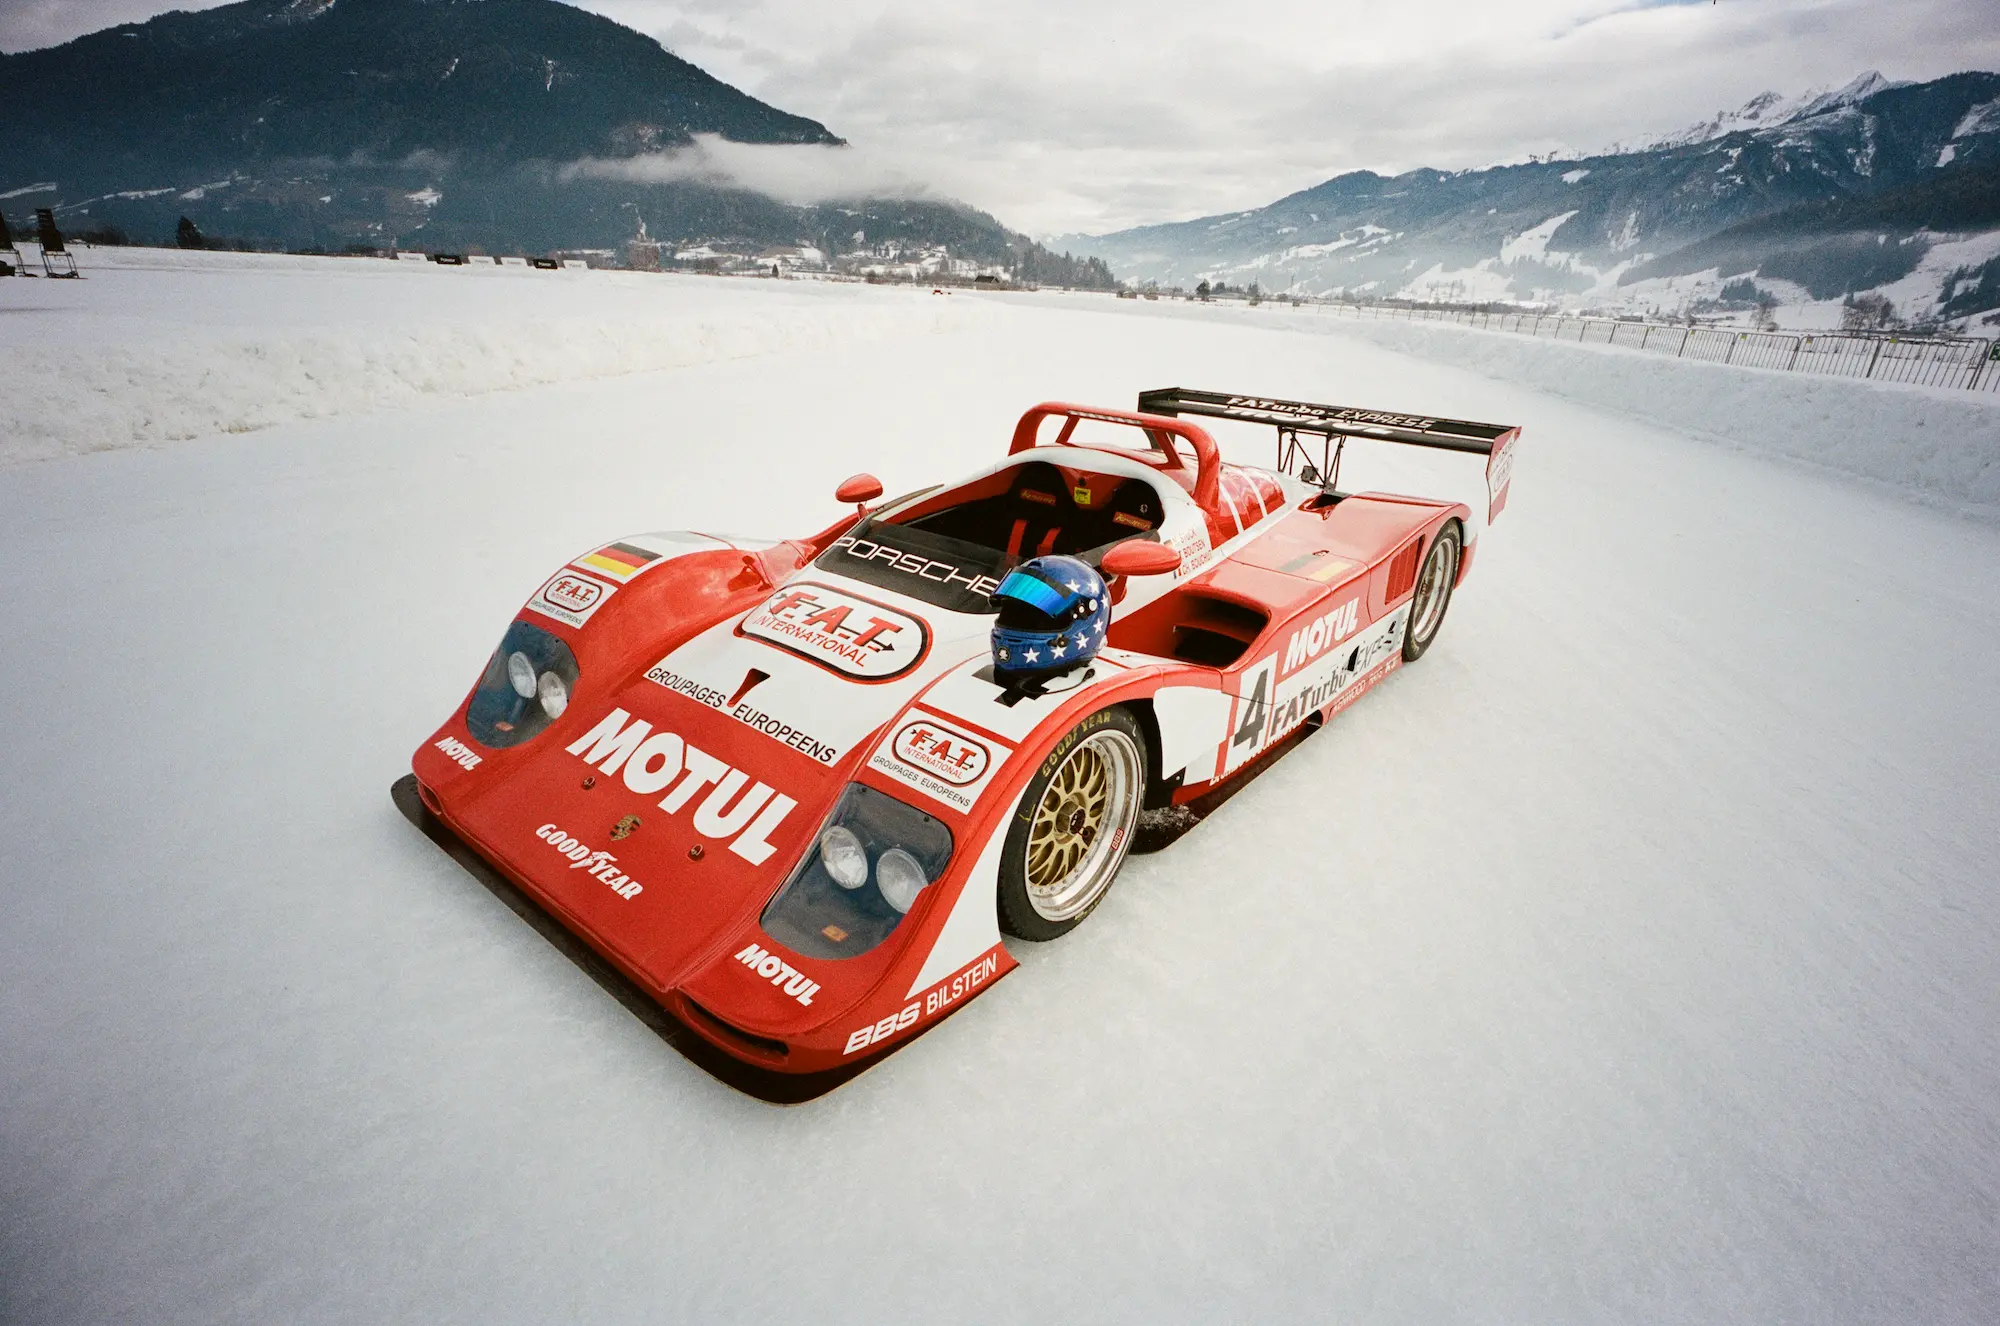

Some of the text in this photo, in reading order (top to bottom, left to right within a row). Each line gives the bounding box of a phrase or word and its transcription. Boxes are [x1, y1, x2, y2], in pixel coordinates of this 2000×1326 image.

[834, 536, 1001, 598] PORSCHE
[752, 614, 870, 668] INTERNATIONAL
[1282, 597, 1360, 676] MOTUL
[648, 667, 837, 763] GROUPAGES EUROPEENS
[1233, 668, 1269, 751] 4
[434, 736, 483, 771] MOTUL
[873, 755, 971, 807] GROUPAGES EUROPEENS
[903, 745, 964, 780] INTERNATIONAL
[565, 707, 799, 867] MOTUL
[535, 823, 644, 900] GOODYEAR
[1111, 829, 1124, 851] BBS
[734, 943, 821, 1007] MOTUL
[843, 953, 997, 1055] BBS BILSTEIN
